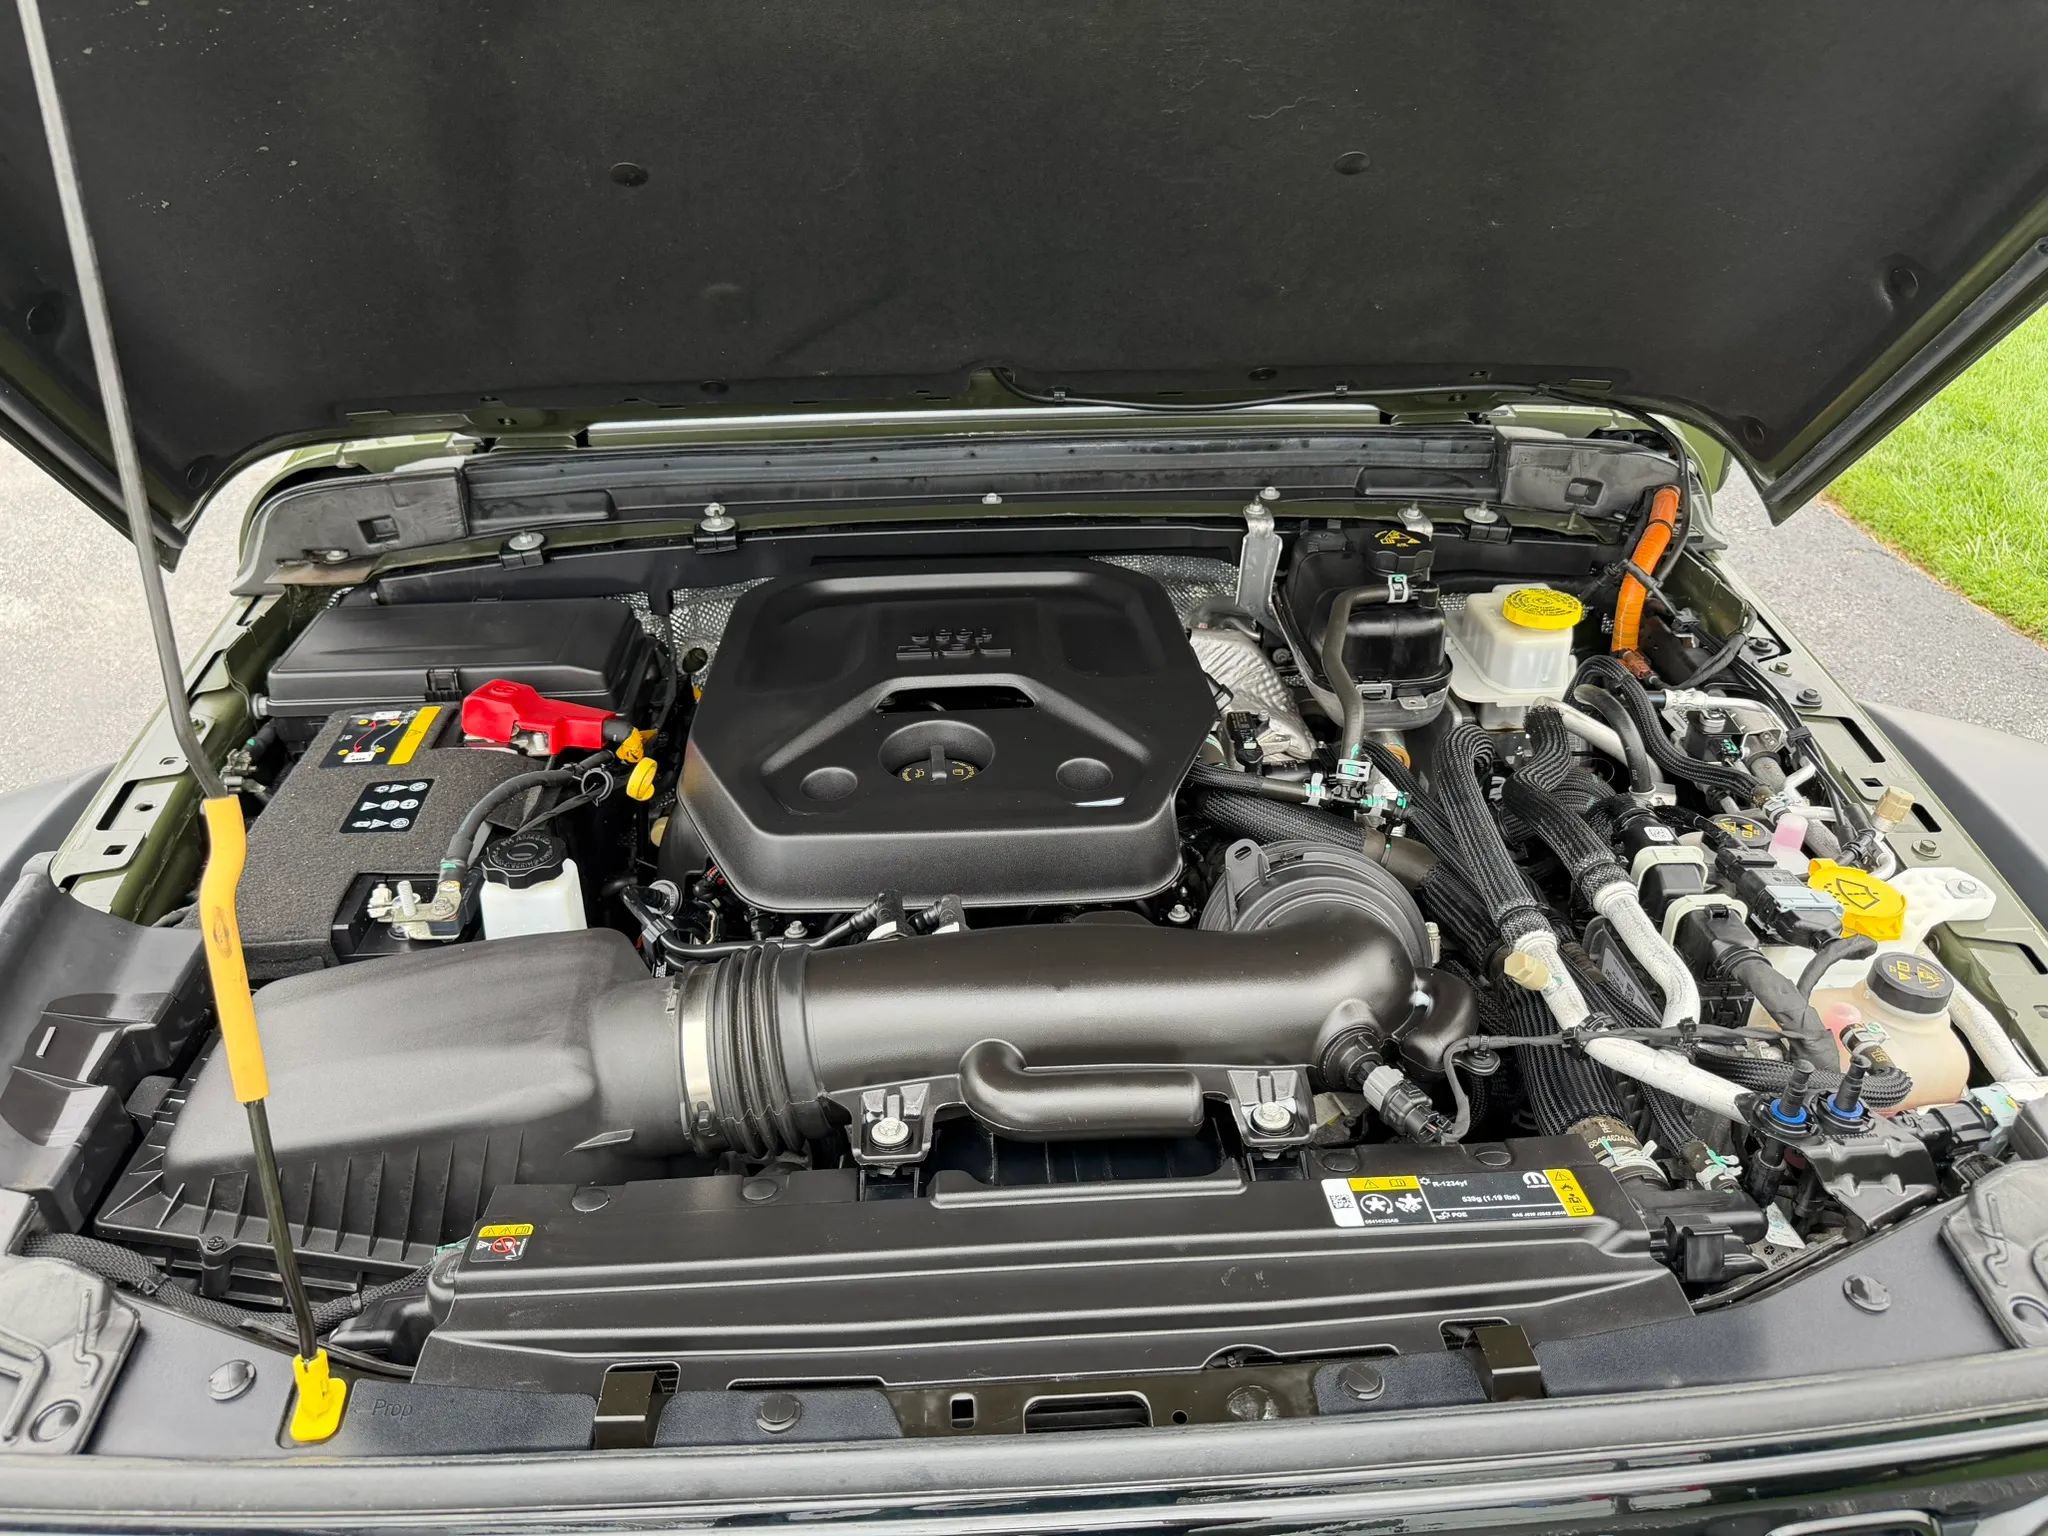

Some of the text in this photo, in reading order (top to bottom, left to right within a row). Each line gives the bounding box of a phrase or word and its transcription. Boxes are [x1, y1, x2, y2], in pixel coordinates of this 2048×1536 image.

[1432, 1179, 1468, 1188] R-1234yf
[1504, 1193, 1521, 1201] lbs)
[372, 1398, 414, 1421] Prop
